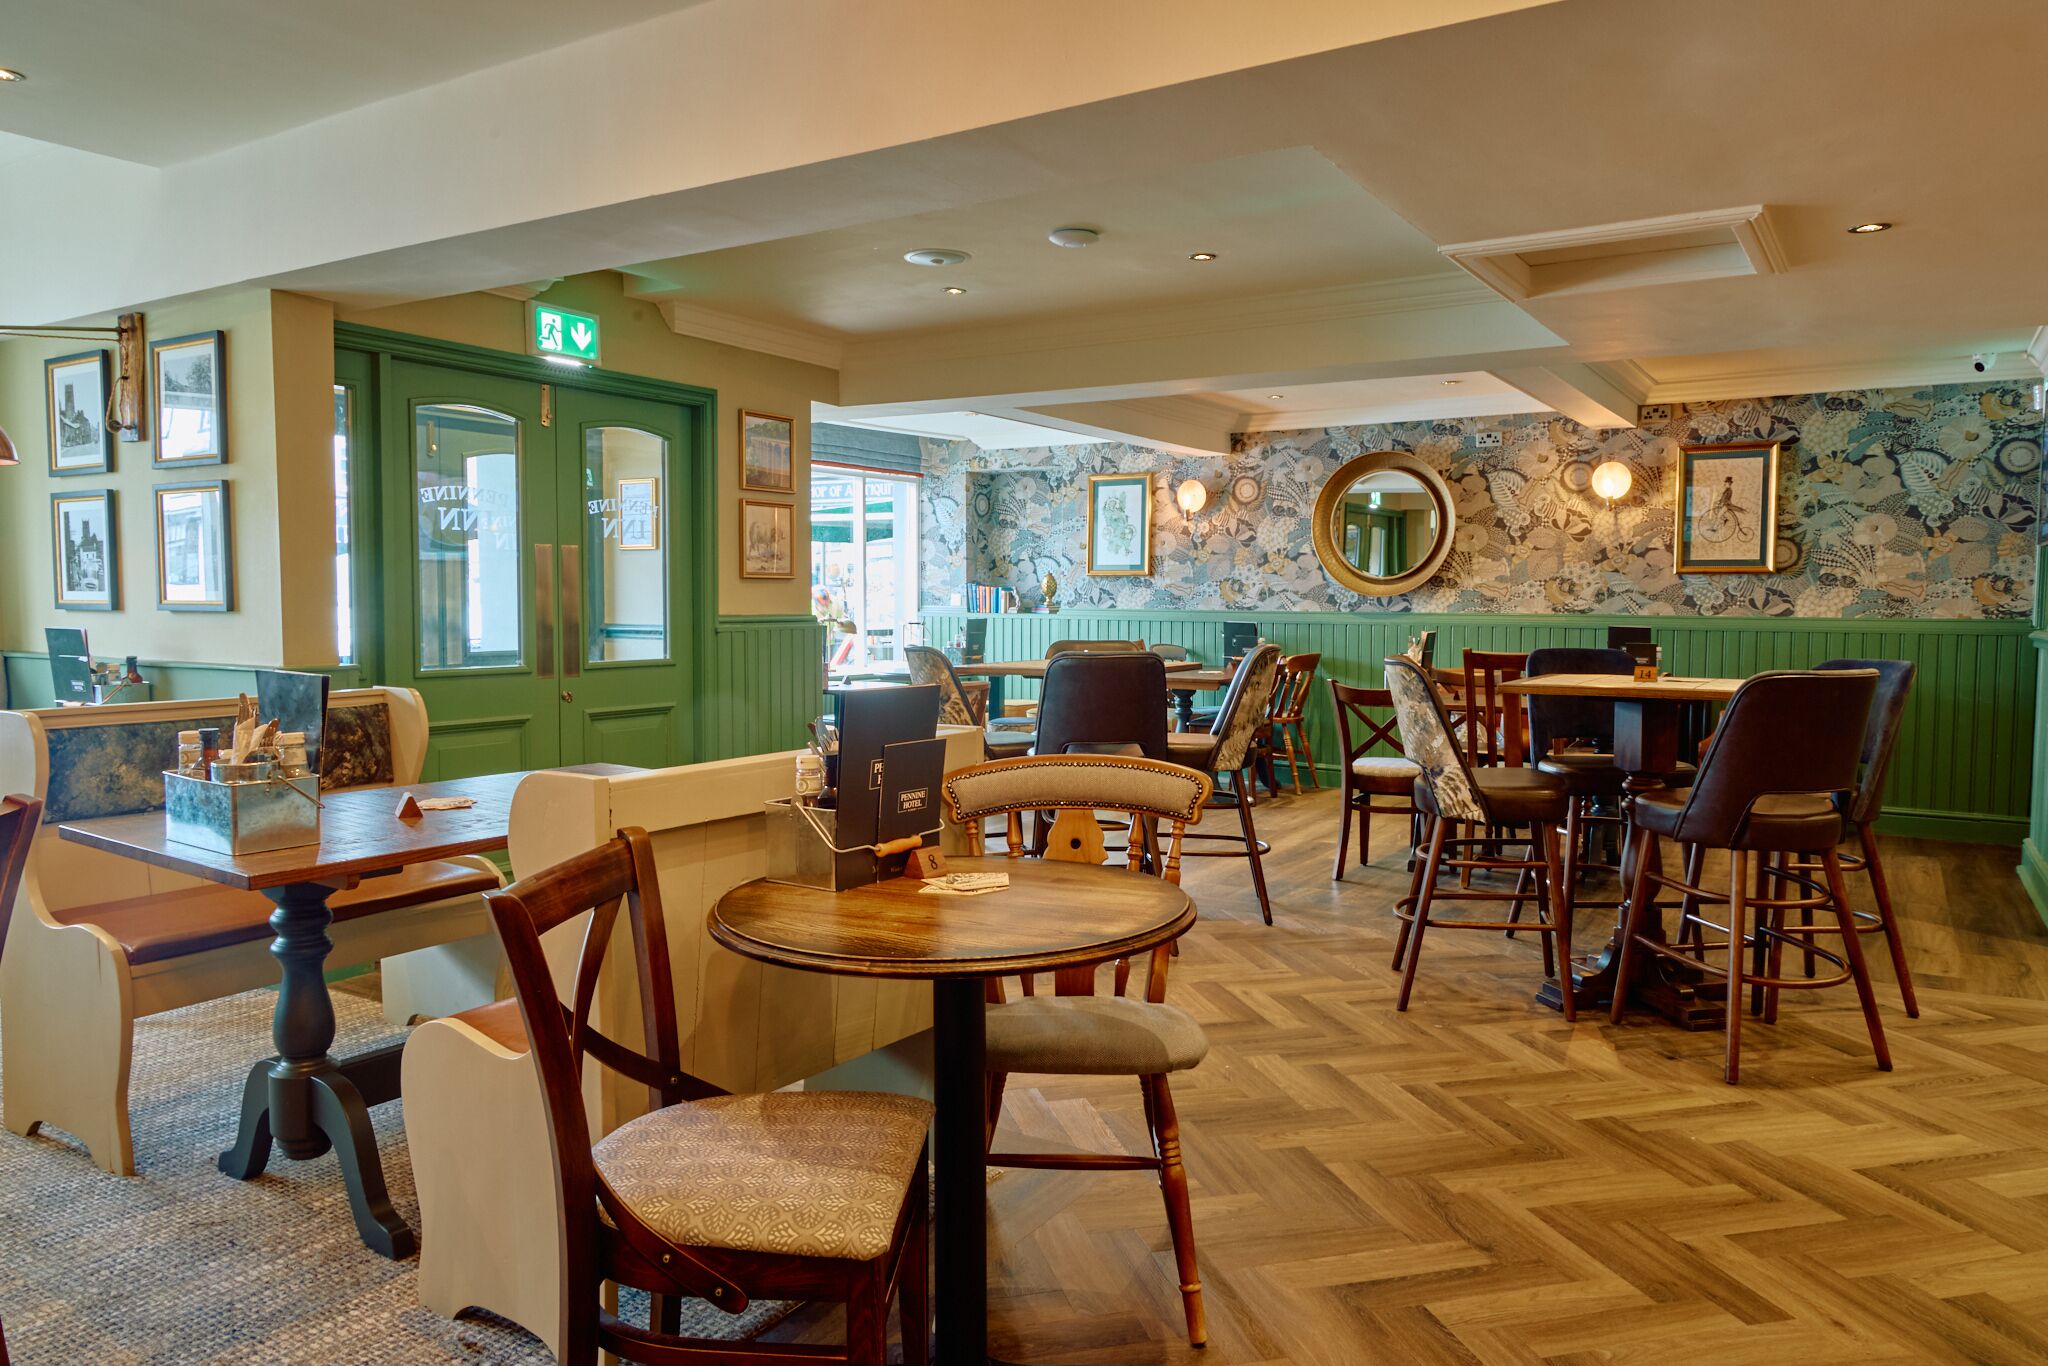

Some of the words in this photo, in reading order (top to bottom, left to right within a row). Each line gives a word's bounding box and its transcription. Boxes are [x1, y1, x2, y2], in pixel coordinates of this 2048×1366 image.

[1640, 669, 1652, 679] 14
[901, 791, 925, 801] PENNINE
[903, 799, 922, 809] HOTEL
[928, 855, 937, 869] 8
